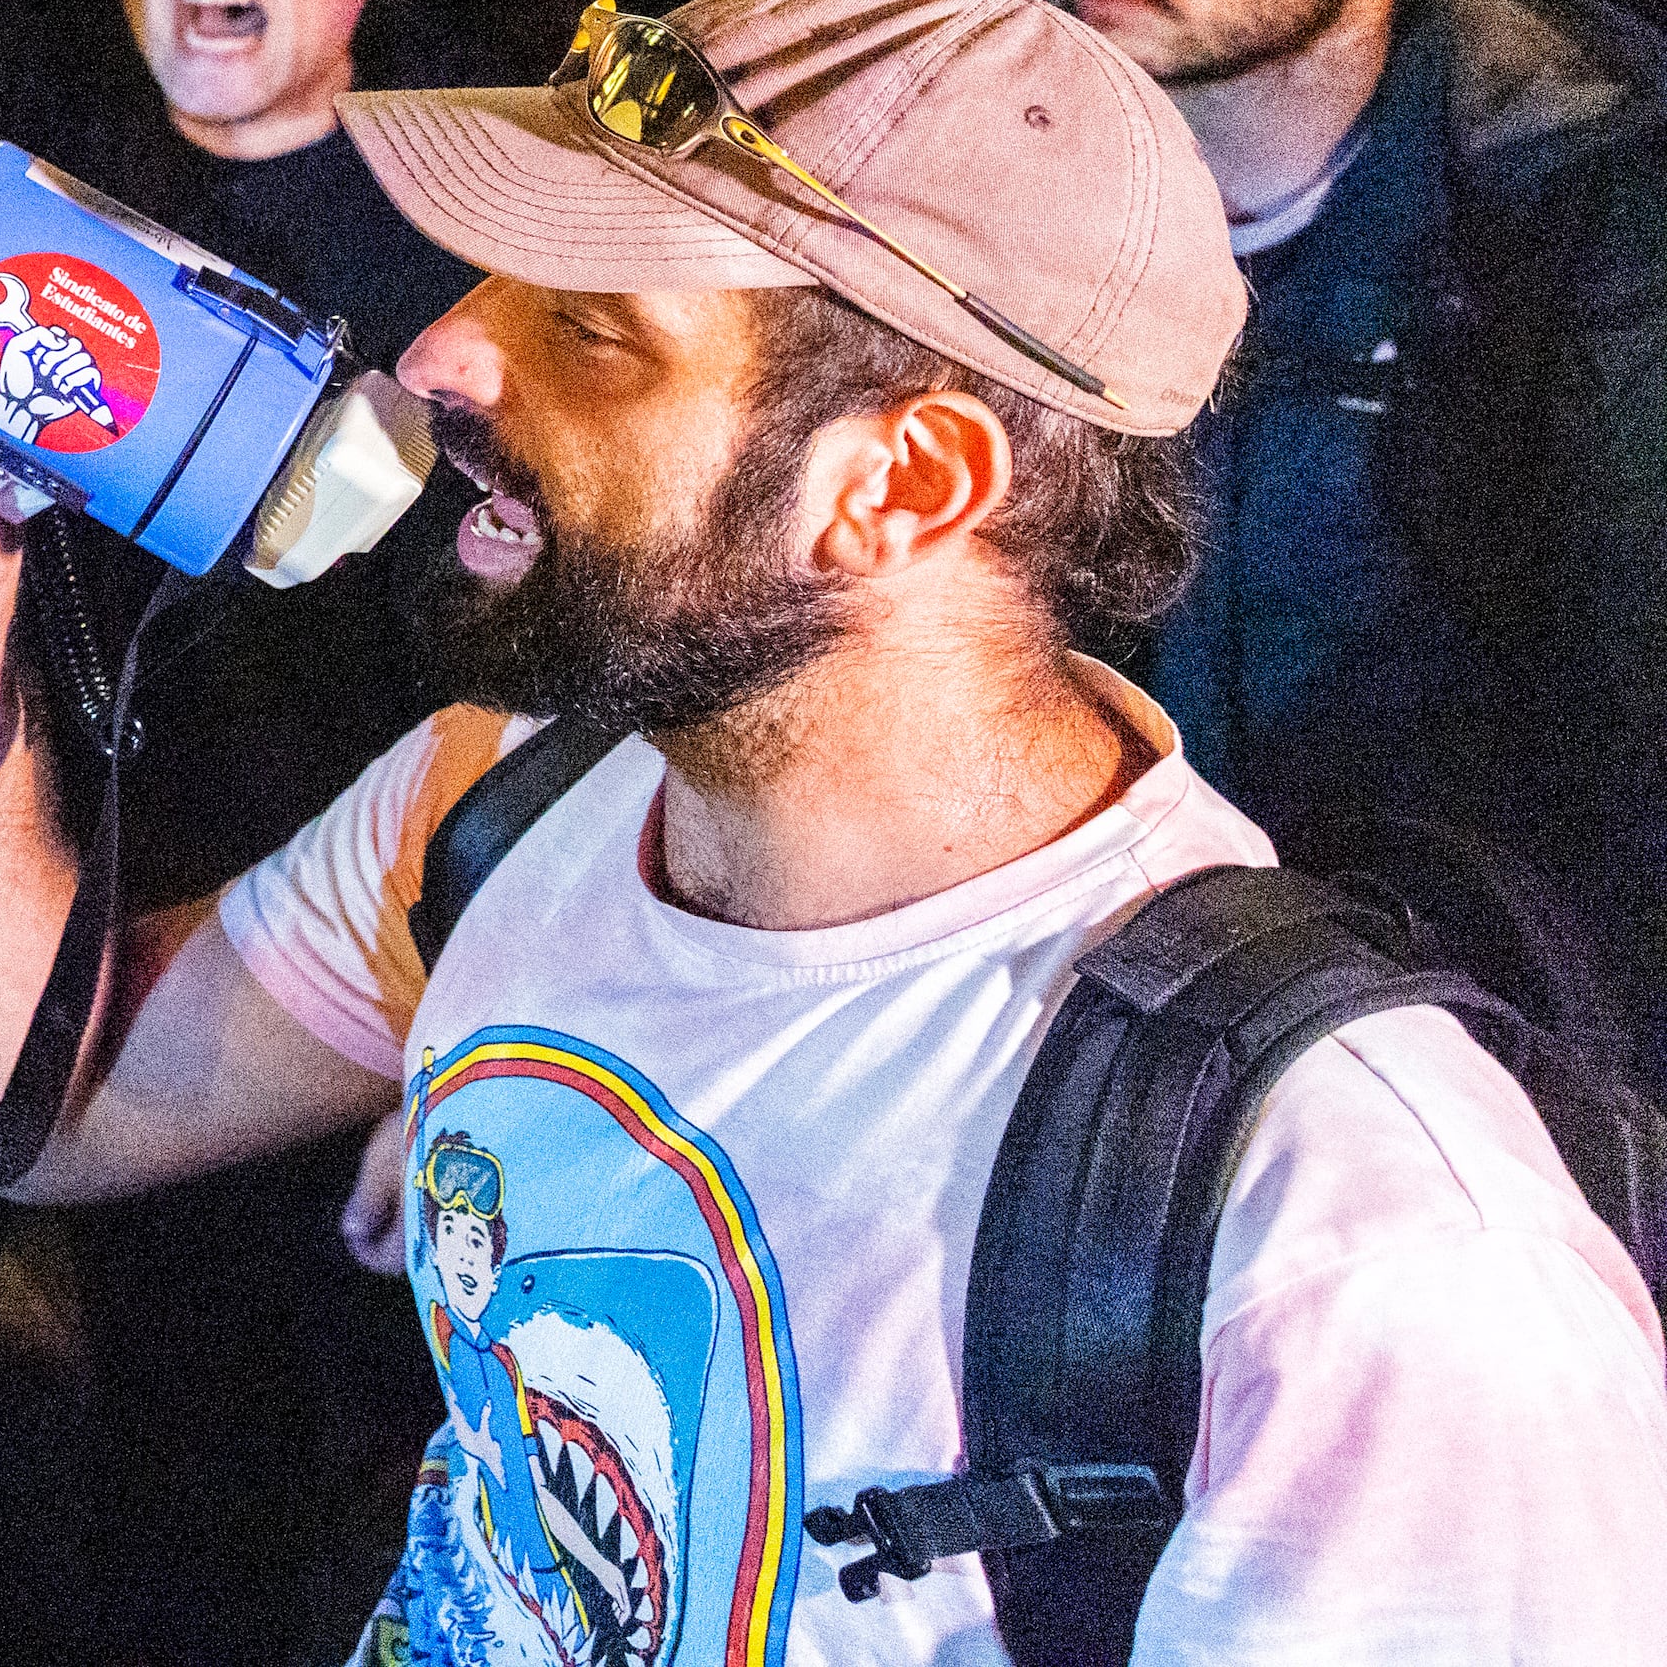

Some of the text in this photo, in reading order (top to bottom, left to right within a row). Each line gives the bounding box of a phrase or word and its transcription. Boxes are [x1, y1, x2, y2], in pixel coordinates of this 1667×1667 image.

[41, 283, 136, 349] Estudiantes
[49, 267, 147, 334] Sindicato de
